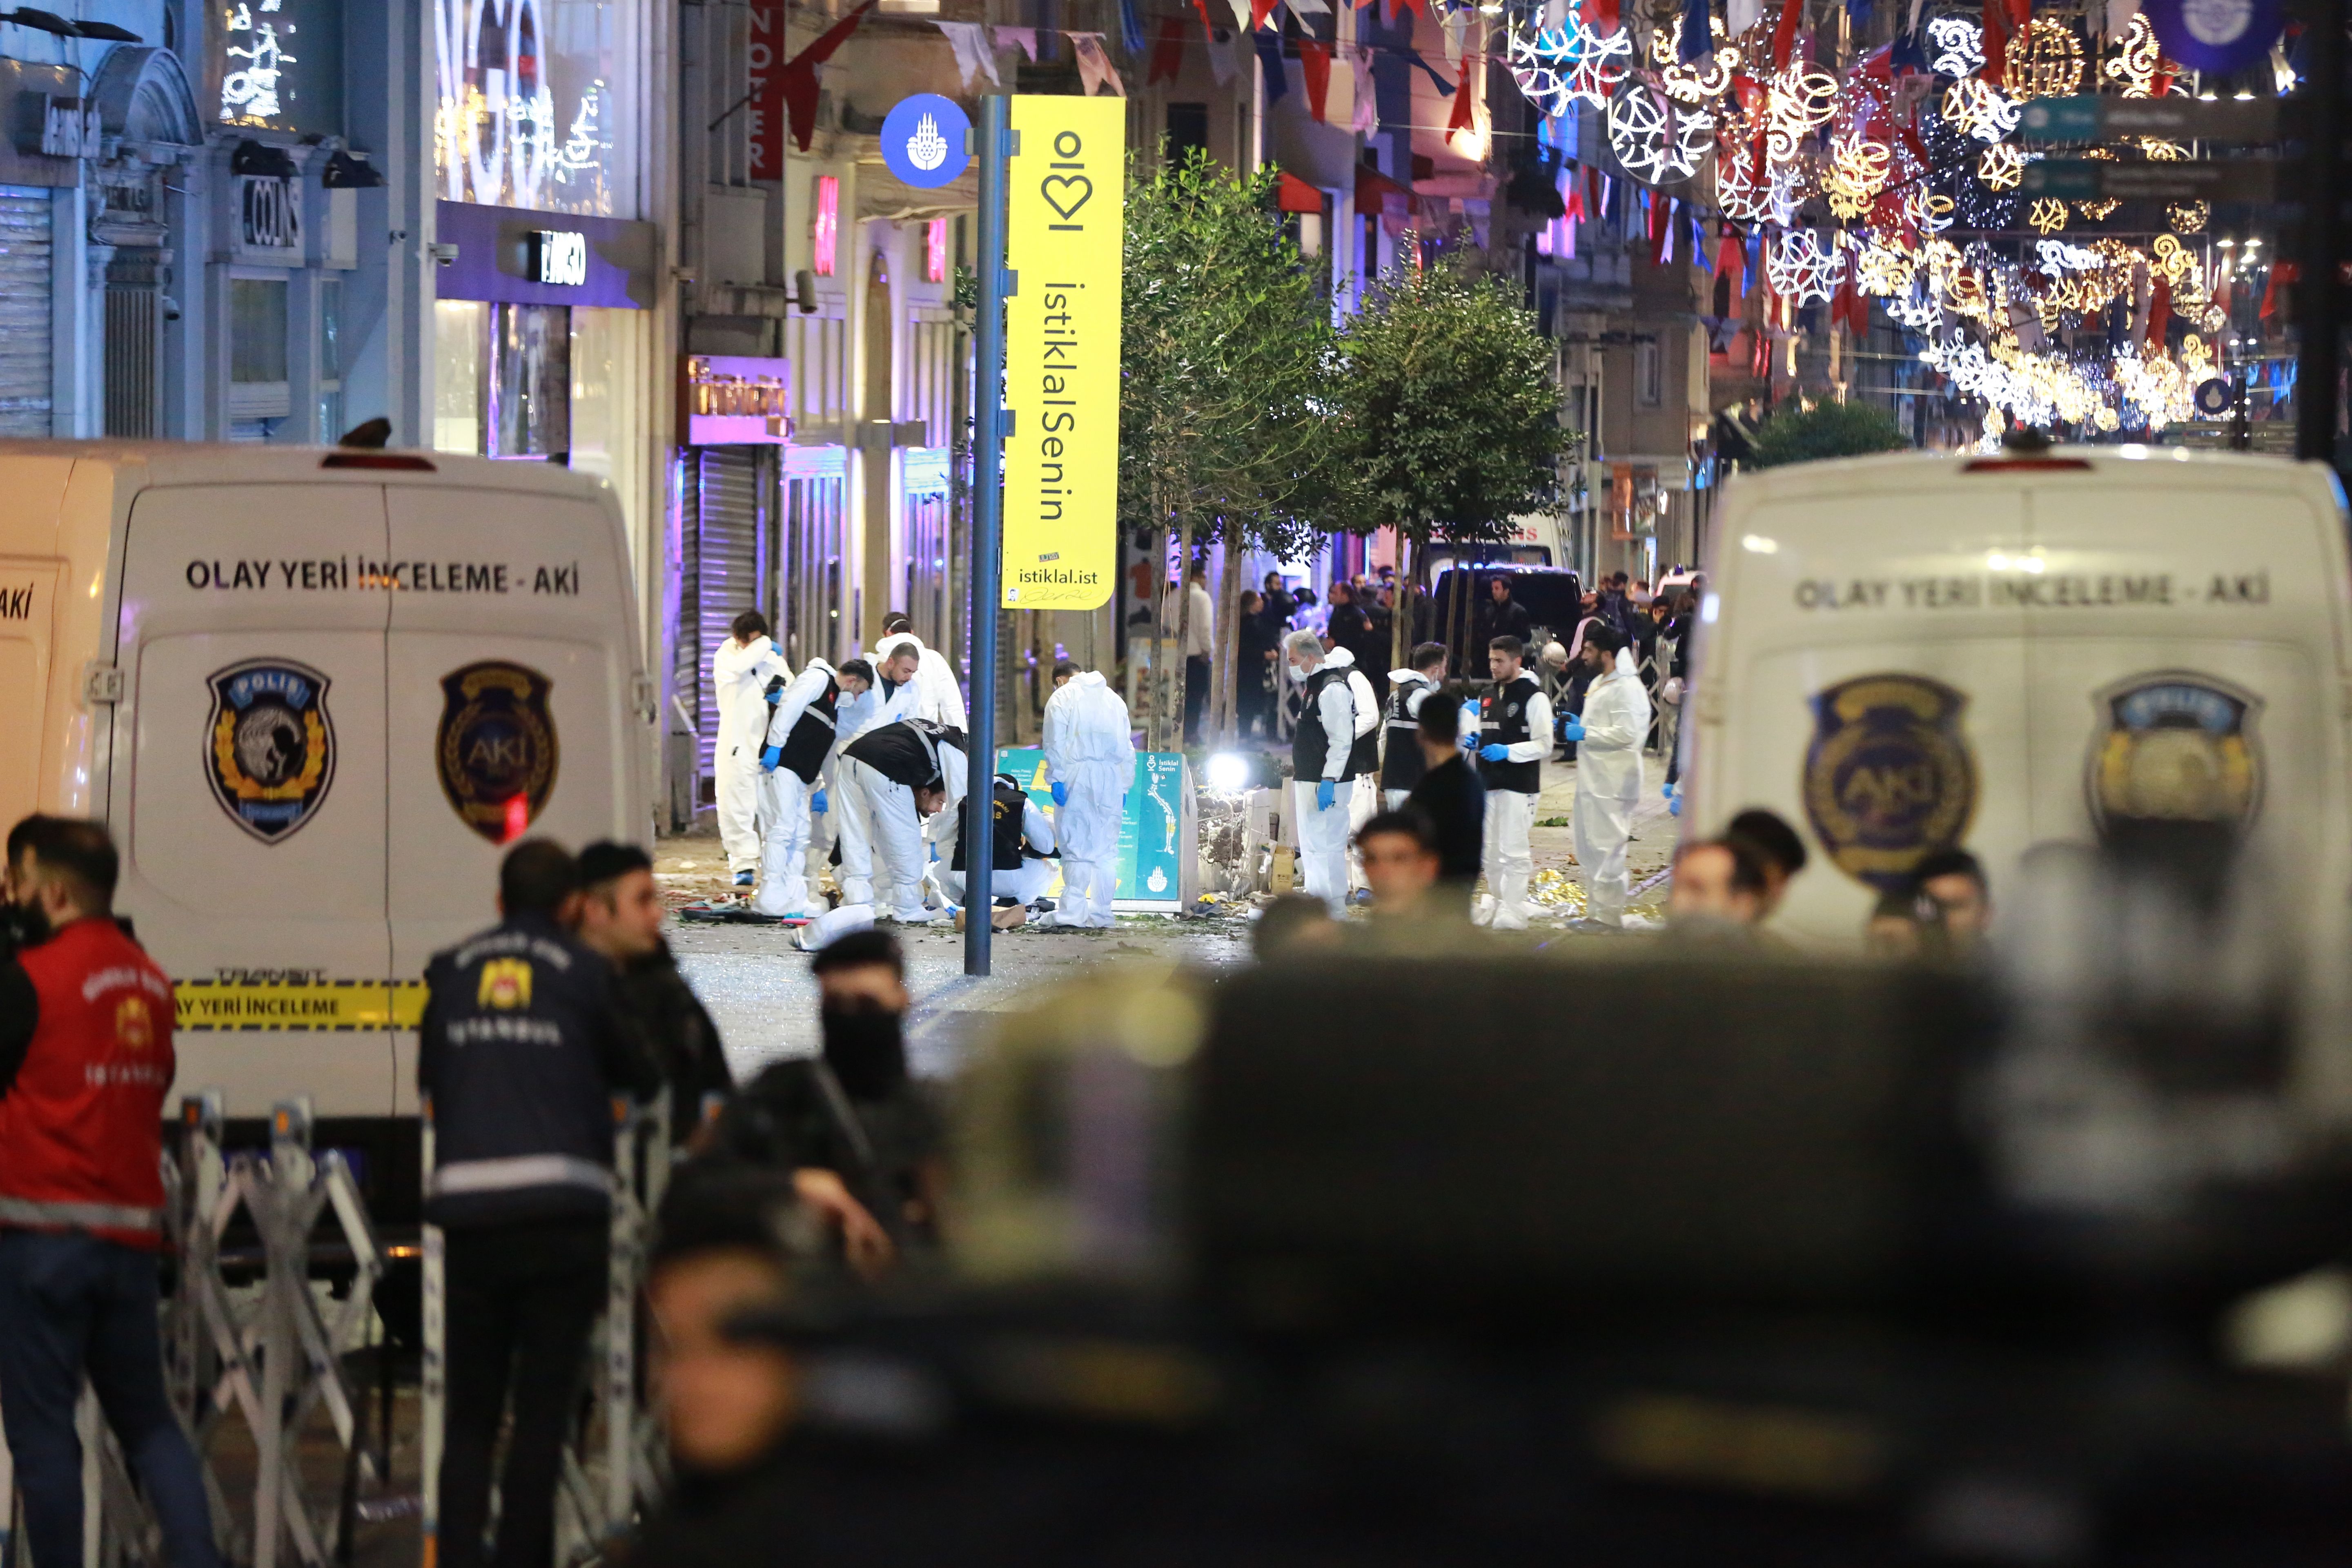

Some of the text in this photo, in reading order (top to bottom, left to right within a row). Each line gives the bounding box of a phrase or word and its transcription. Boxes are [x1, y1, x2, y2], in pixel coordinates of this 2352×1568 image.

[186, 560, 270, 590] OLAY
[279, 555, 348, 590] YERİ
[358, 555, 509, 594] İNCELEME
[534, 560, 580, 595] AKİ
[1020, 569, 1098, 584] istiklal.ist
[200, 995, 240, 1016] YERİ
[247, 995, 340, 1016] İNCELEME
